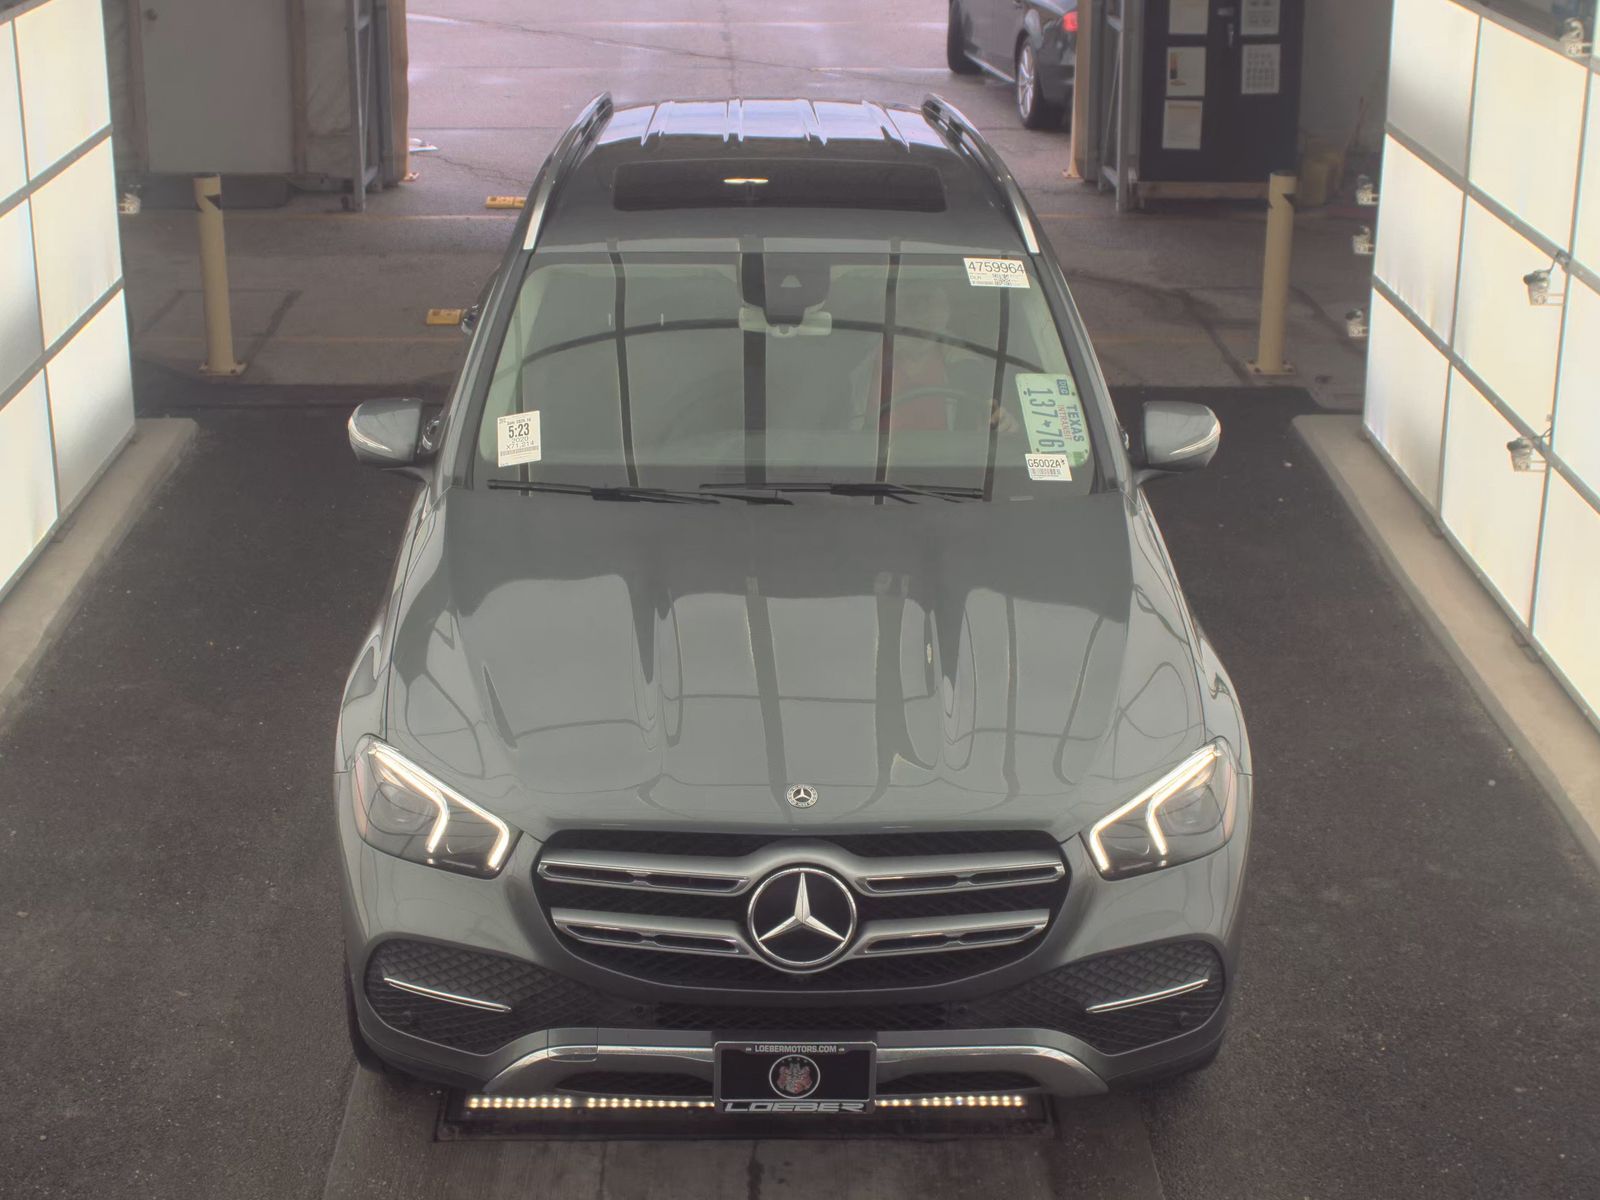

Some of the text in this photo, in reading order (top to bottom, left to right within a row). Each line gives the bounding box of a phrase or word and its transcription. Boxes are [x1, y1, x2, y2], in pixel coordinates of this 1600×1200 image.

[968, 261, 1025, 274] 4759964
[1067, 404, 1085, 442] TEXAS
[508, 422, 530, 438] 5:23
[754, 1045, 837, 1053] LOEBERMOTORS.COM
[724, 1102, 865, 1112] LOEBER
